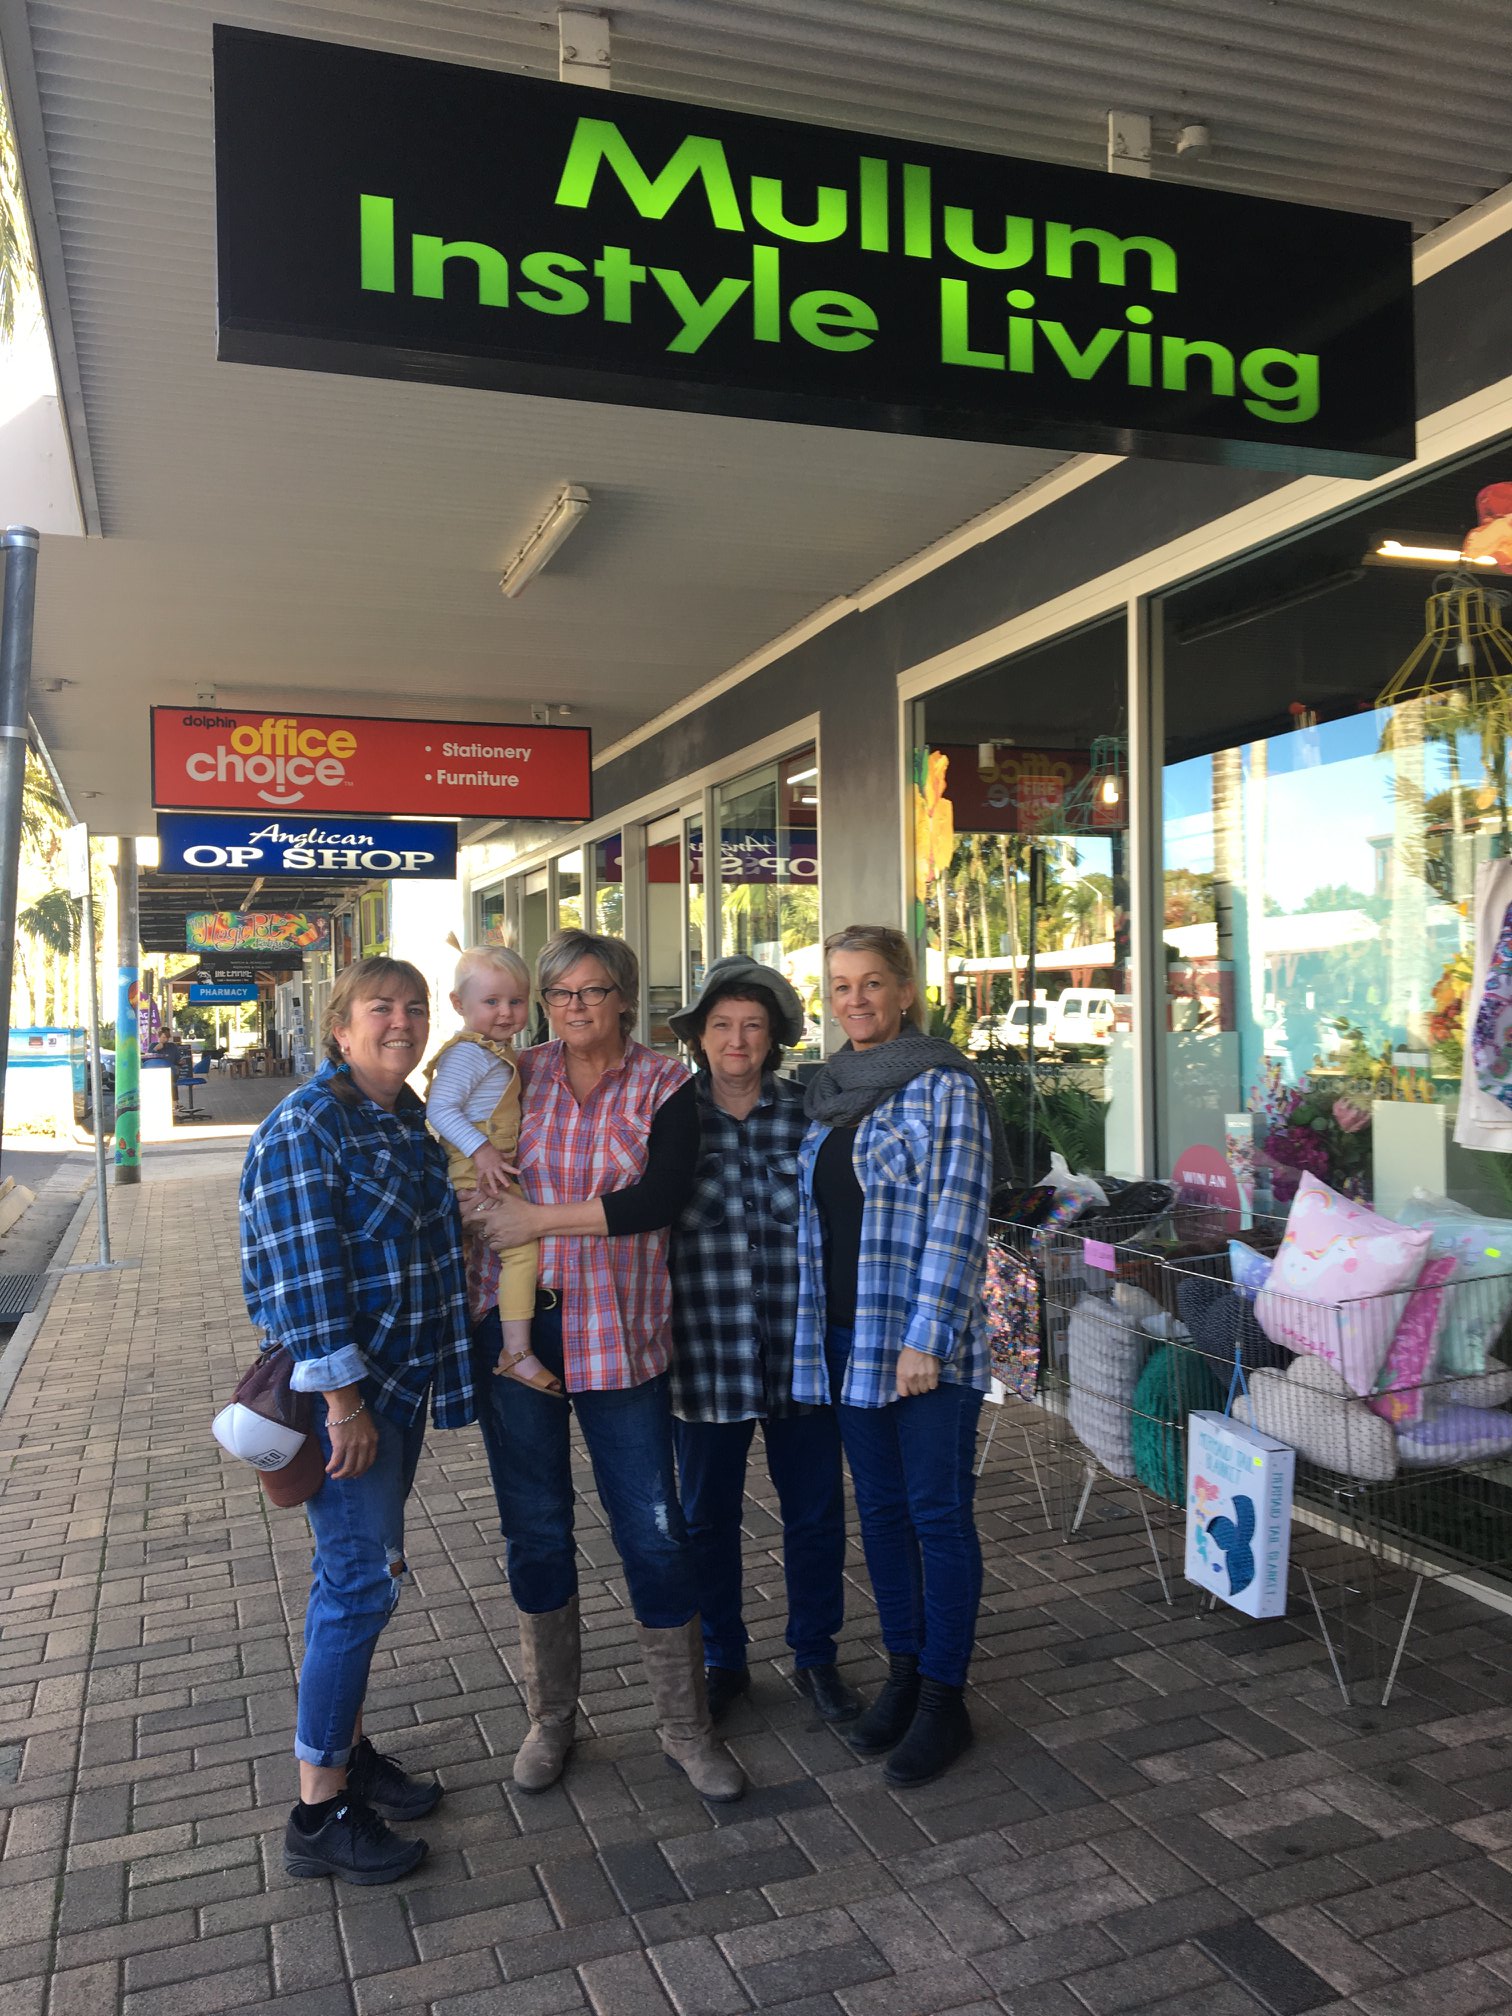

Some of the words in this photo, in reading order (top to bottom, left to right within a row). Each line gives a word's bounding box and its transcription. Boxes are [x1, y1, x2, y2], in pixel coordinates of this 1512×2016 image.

[555, 117, 1178, 294] Mullum
[360, 194, 879, 353] Instyle
[941, 278, 1320, 423] Living
[183, 715, 236, 730] dolphin
[230, 718, 357, 758] office
[442, 742, 531, 762] Stationery
[186, 745, 345, 793] choice
[437, 769, 519, 787] Furniture
[249, 824, 374, 848] Anglican
[183, 846, 263, 867] OP
[283, 849, 434, 871] SHOP
[191, 914, 251, 951] Magic
[200, 988, 248, 996] PHARMACY
[1182, 1170, 1207, 1186] WIN
[1208, 1174, 1227, 1188] AN
